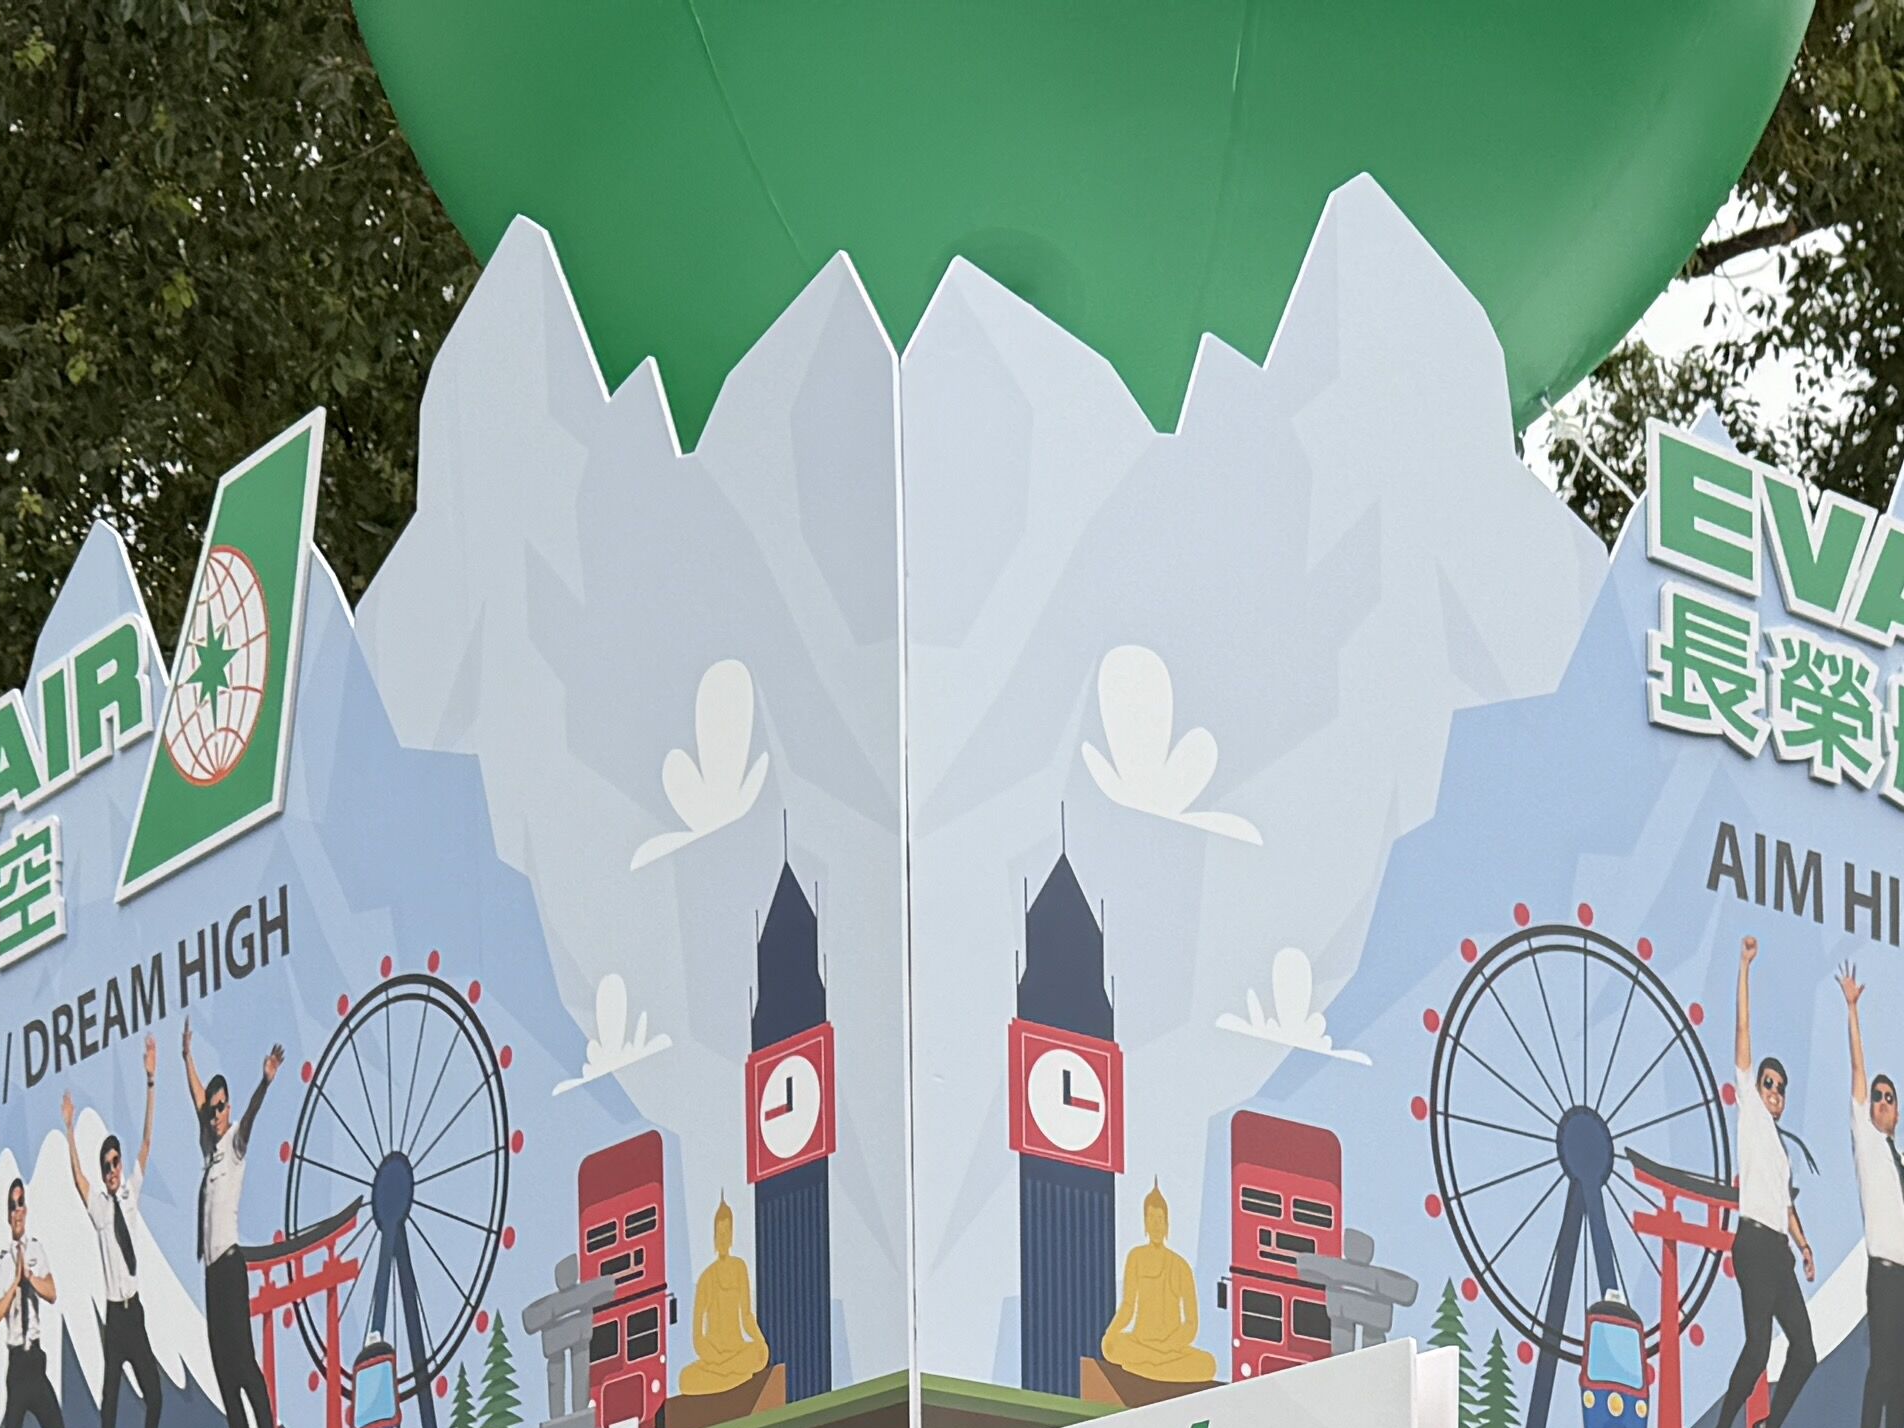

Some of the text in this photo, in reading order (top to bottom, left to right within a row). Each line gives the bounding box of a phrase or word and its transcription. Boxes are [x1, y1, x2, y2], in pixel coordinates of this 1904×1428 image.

[1705, 822, 1824, 924] AIM
[24, 952, 167, 1089] DREAM
[179, 885, 292, 1012] HIGH
